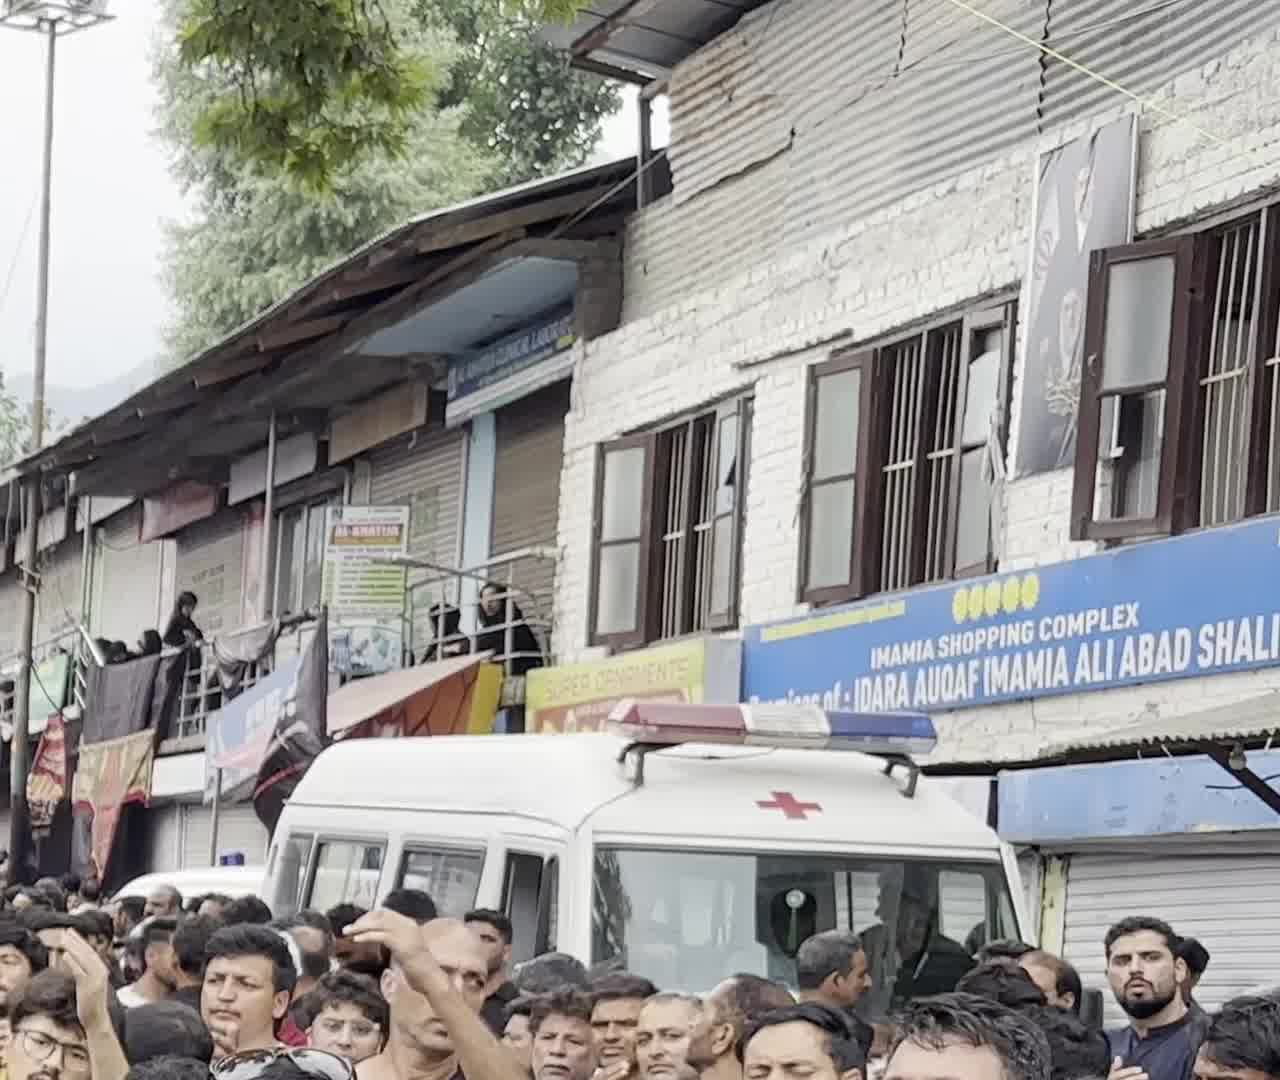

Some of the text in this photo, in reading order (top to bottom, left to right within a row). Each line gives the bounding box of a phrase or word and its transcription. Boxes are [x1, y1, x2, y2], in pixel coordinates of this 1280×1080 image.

[854, 671, 916, 712] IDARA
[917, 659, 980, 702] AUQAF
[983, 645, 1069, 697] IMAMIA
[1074, 638, 1115, 684] ALI
[1119, 627, 1191, 680] ABAD
[870, 638, 935, 670] IMAMIA
[938, 619, 1034, 659] SHOPPING
[1038, 602, 1140, 642] COMPLEX
